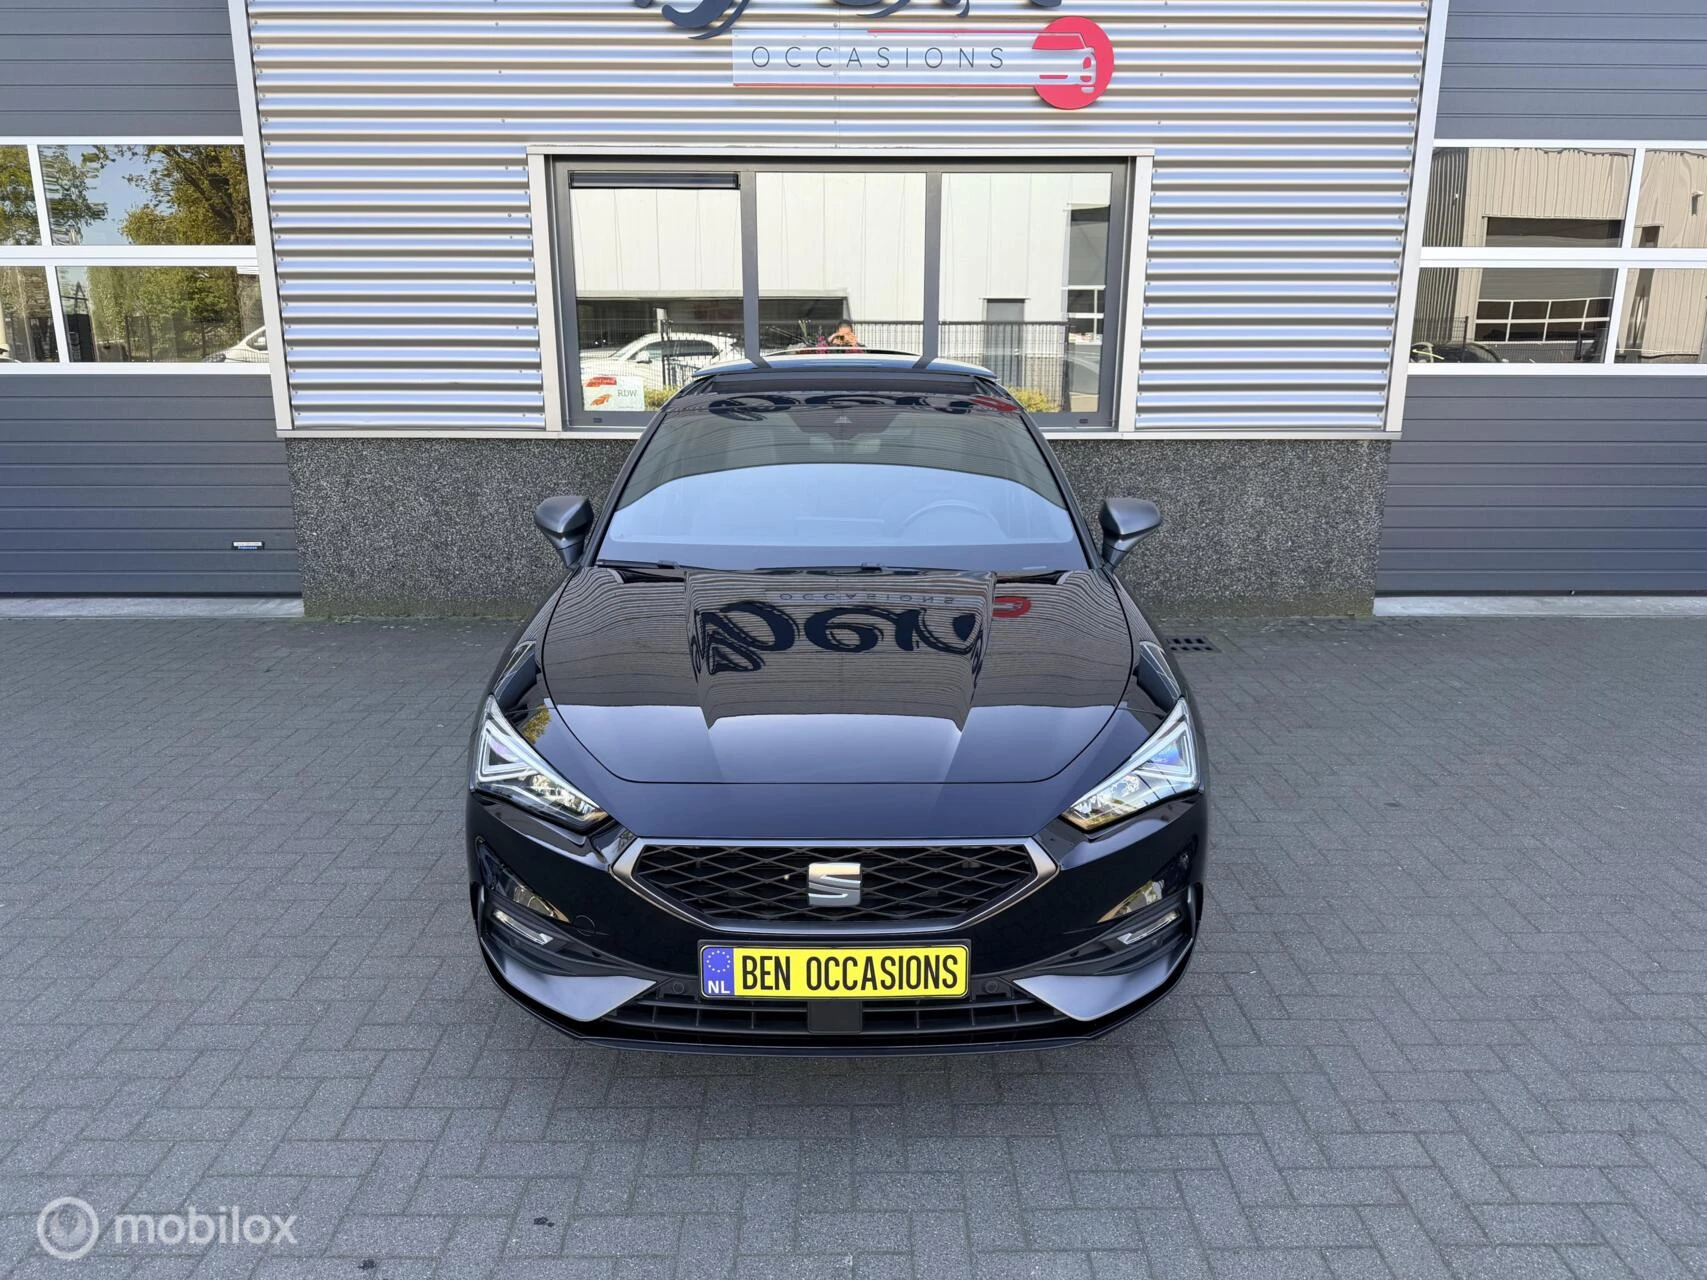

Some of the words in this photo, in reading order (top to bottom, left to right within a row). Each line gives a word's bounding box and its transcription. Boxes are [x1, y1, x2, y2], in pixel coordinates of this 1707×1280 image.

[751, 46, 1005, 69] OCCASIONS
[617, 389, 638, 398] RDW
[741, 955, 791, 991] BEN
[805, 954, 958, 991] OCCASIONS
[707, 980, 731, 994] NL
